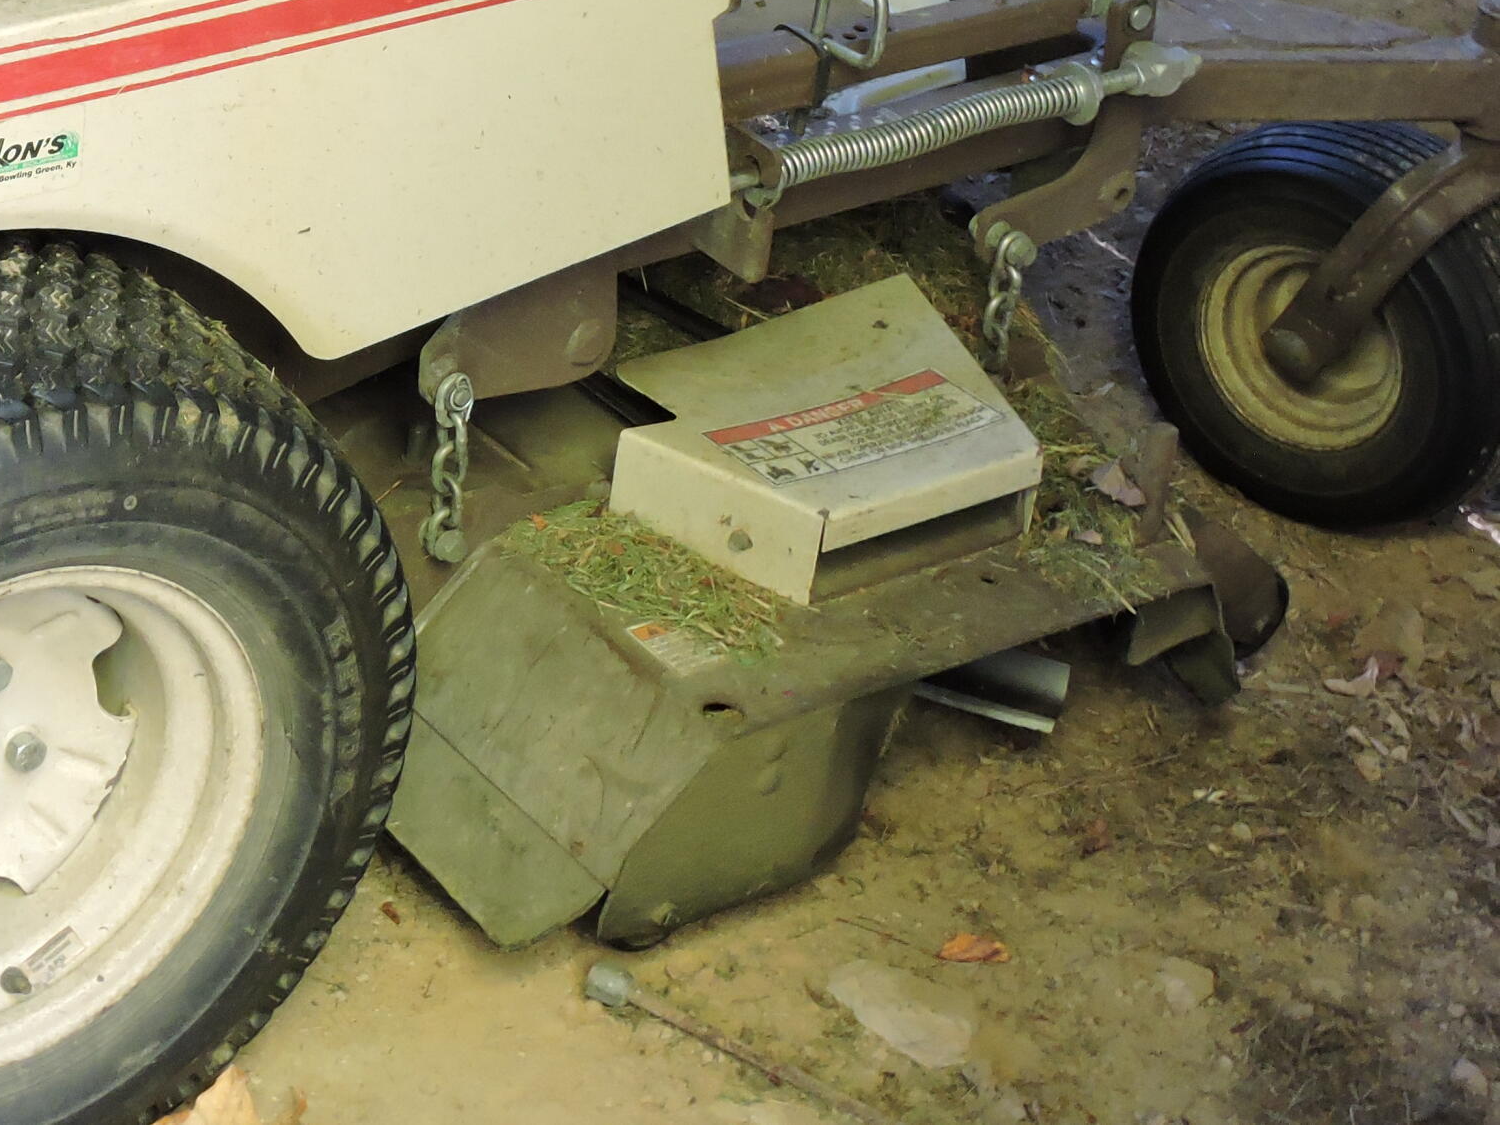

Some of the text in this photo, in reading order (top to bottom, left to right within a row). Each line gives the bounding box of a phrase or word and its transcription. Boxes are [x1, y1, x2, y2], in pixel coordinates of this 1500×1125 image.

[35, 164, 63, 175] Green,
[65, 160, 77, 170] Ky
[784, 398, 864, 427] DANGER
